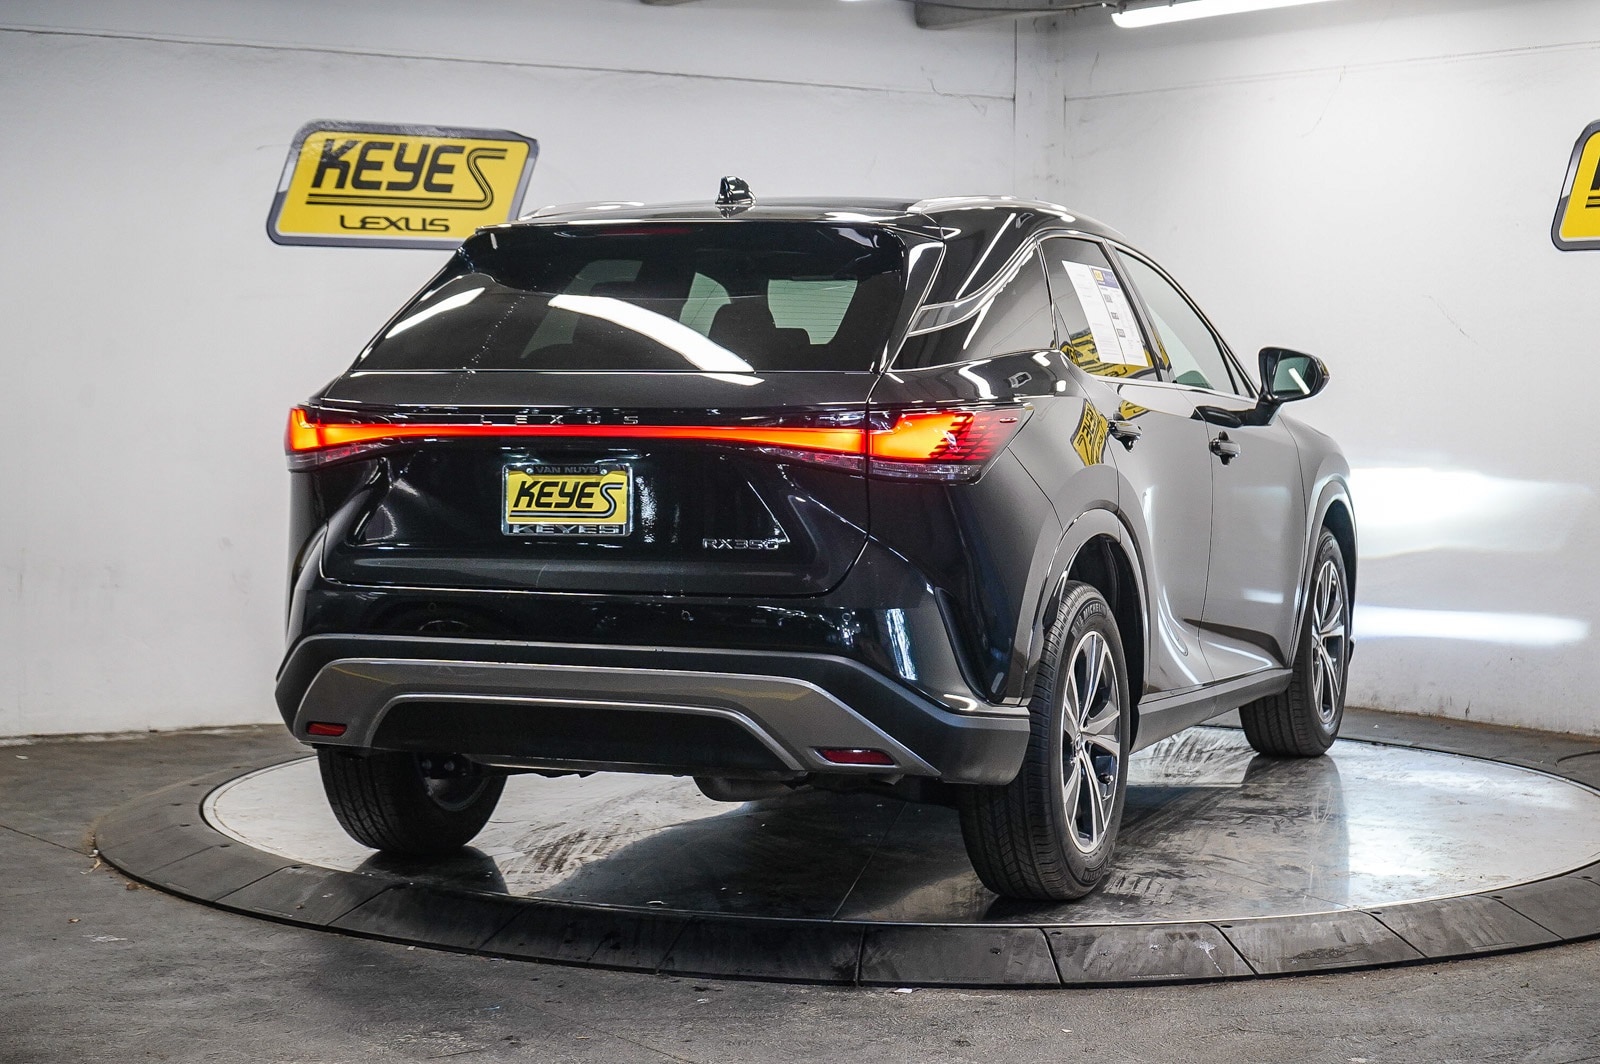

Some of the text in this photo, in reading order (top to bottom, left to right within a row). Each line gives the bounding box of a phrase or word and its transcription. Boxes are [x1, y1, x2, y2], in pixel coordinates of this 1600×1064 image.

[306, 138, 507, 210] KEYES
[339, 215, 450, 232] LEXUS
[481, 415, 638, 424] LEXUS
[510, 481, 624, 518] KEYES
[513, 524, 620, 534] KEYES
